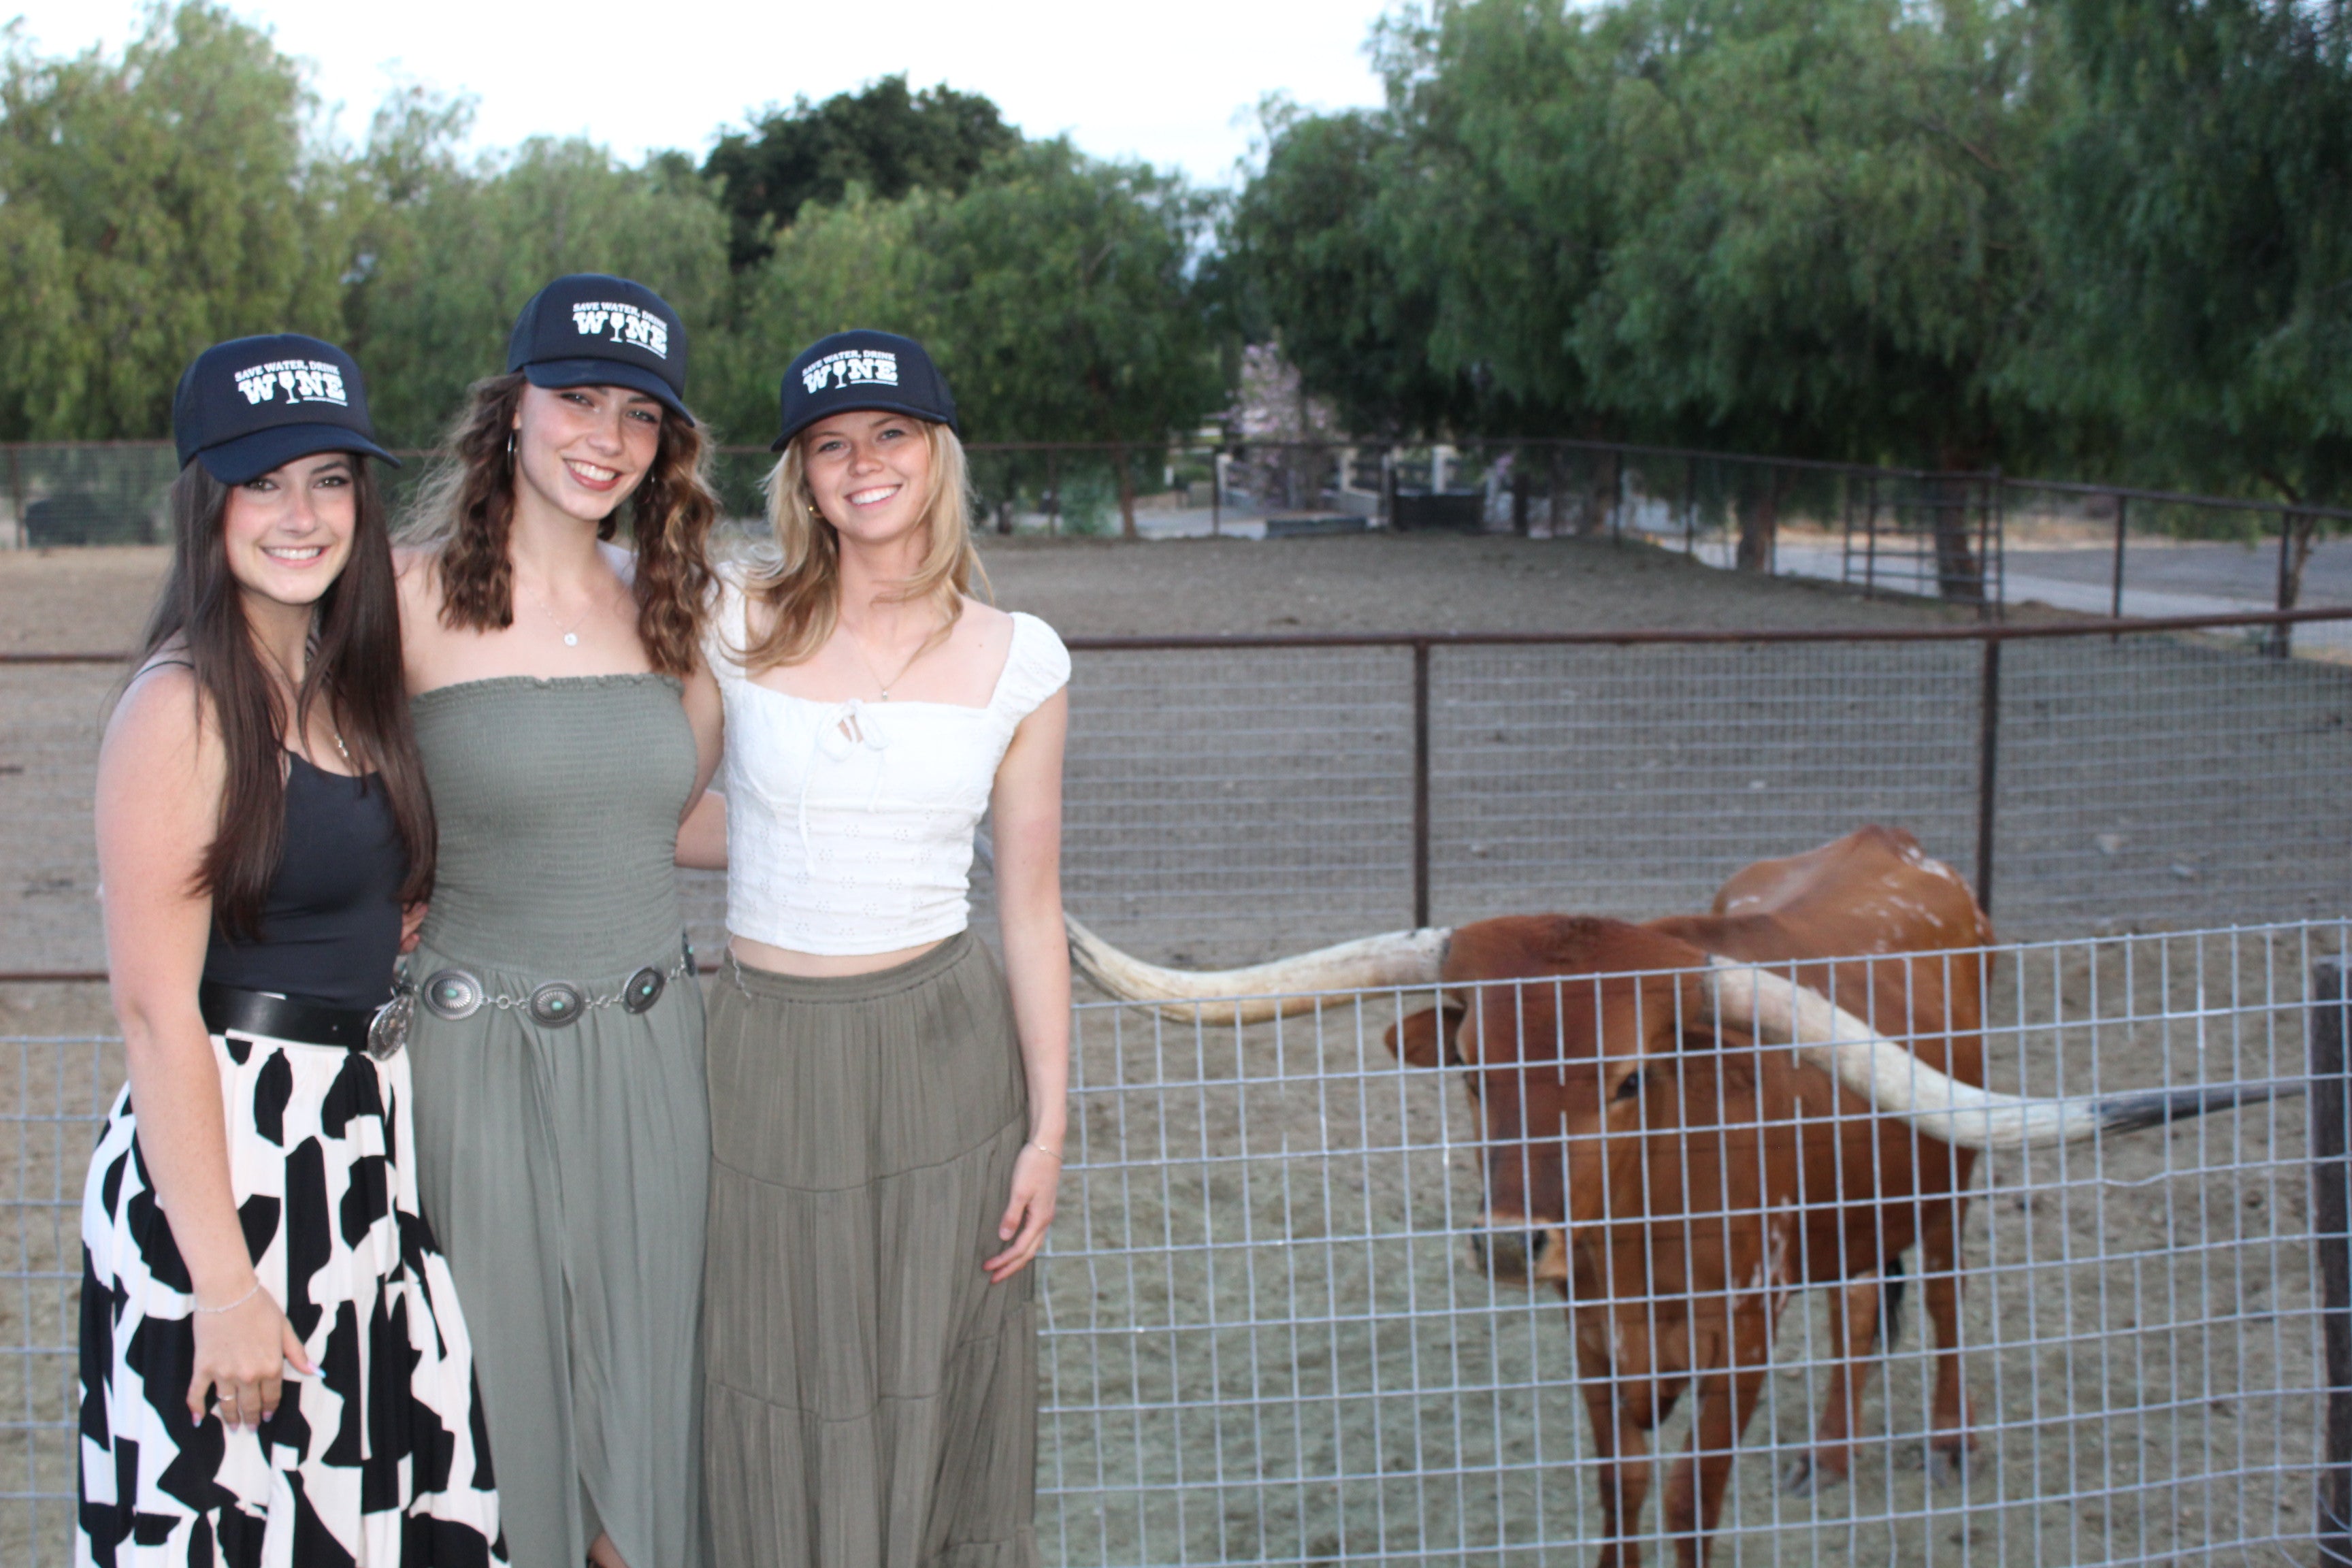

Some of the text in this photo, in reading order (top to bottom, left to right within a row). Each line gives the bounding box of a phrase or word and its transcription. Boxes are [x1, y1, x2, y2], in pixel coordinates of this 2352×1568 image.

[573, 301, 600, 312] SAVE
[600, 301, 640, 318] WATER,
[572, 310, 668, 355] WINE
[235, 359, 340, 382] SAVE WATER, DRINK
[823, 350, 862, 364] WATER,
[862, 350, 896, 361] DRINK
[238, 370, 346, 405] WINE
[802, 358, 898, 394] WINE
